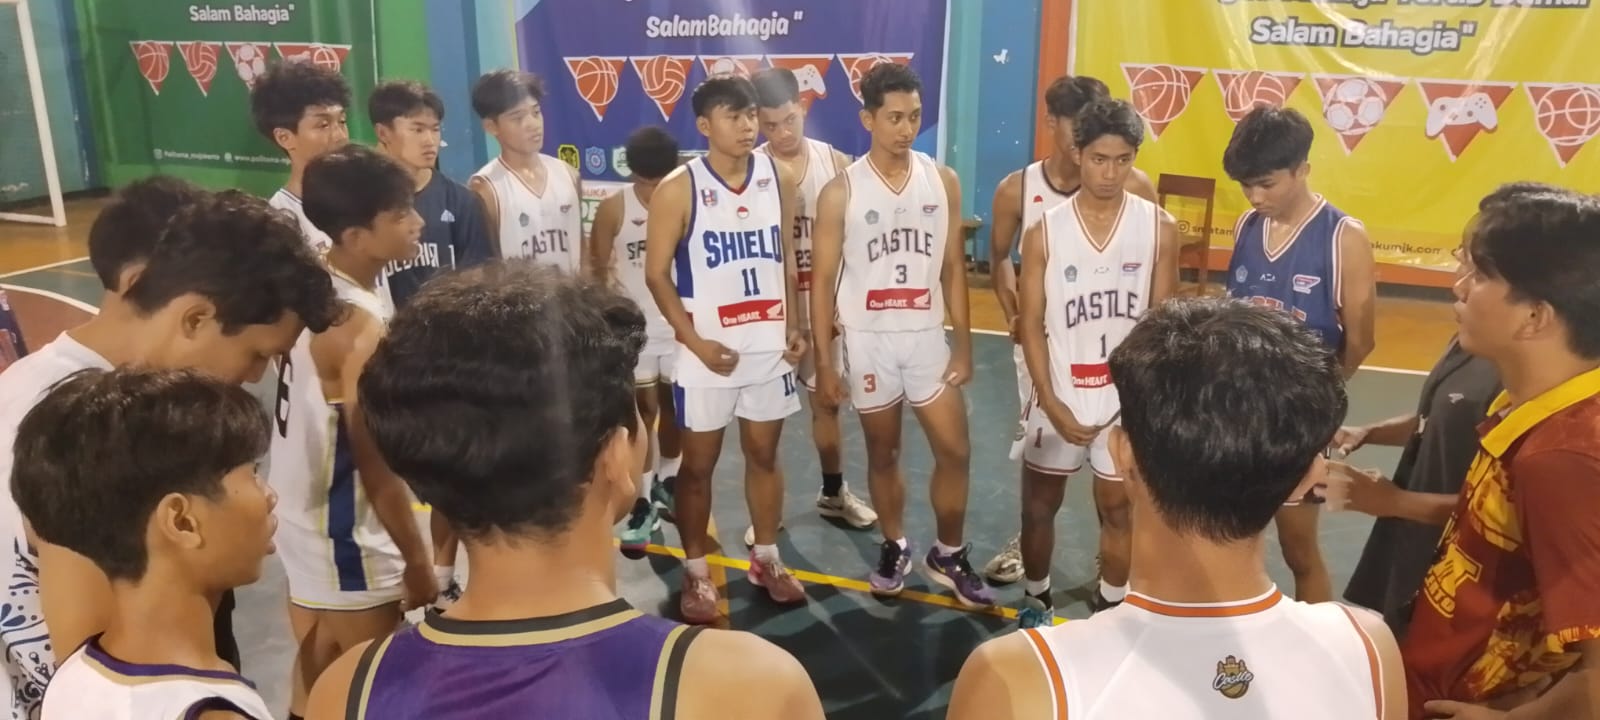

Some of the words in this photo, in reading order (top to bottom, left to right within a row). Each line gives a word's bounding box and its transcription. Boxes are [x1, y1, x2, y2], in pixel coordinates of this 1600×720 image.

[189, 5, 231, 21] Salam
[234, 4, 295, 25] Bahagia"
[646, 12, 790, 41] SalamBahagia
[1251, 16, 1337, 47] Salam
[1341, 19, 1477, 56] Bahagia"
[703, 224, 782, 269] SHIELD
[867, 228, 934, 263] CASTLE
[742, 267, 760, 297] 11
[896, 264, 907, 284] 3
[1066, 290, 1139, 329] CASTLE
[1100, 334, 1107, 358] 1
[864, 374, 877, 393] 3
[1033, 426, 1043, 449] 1
